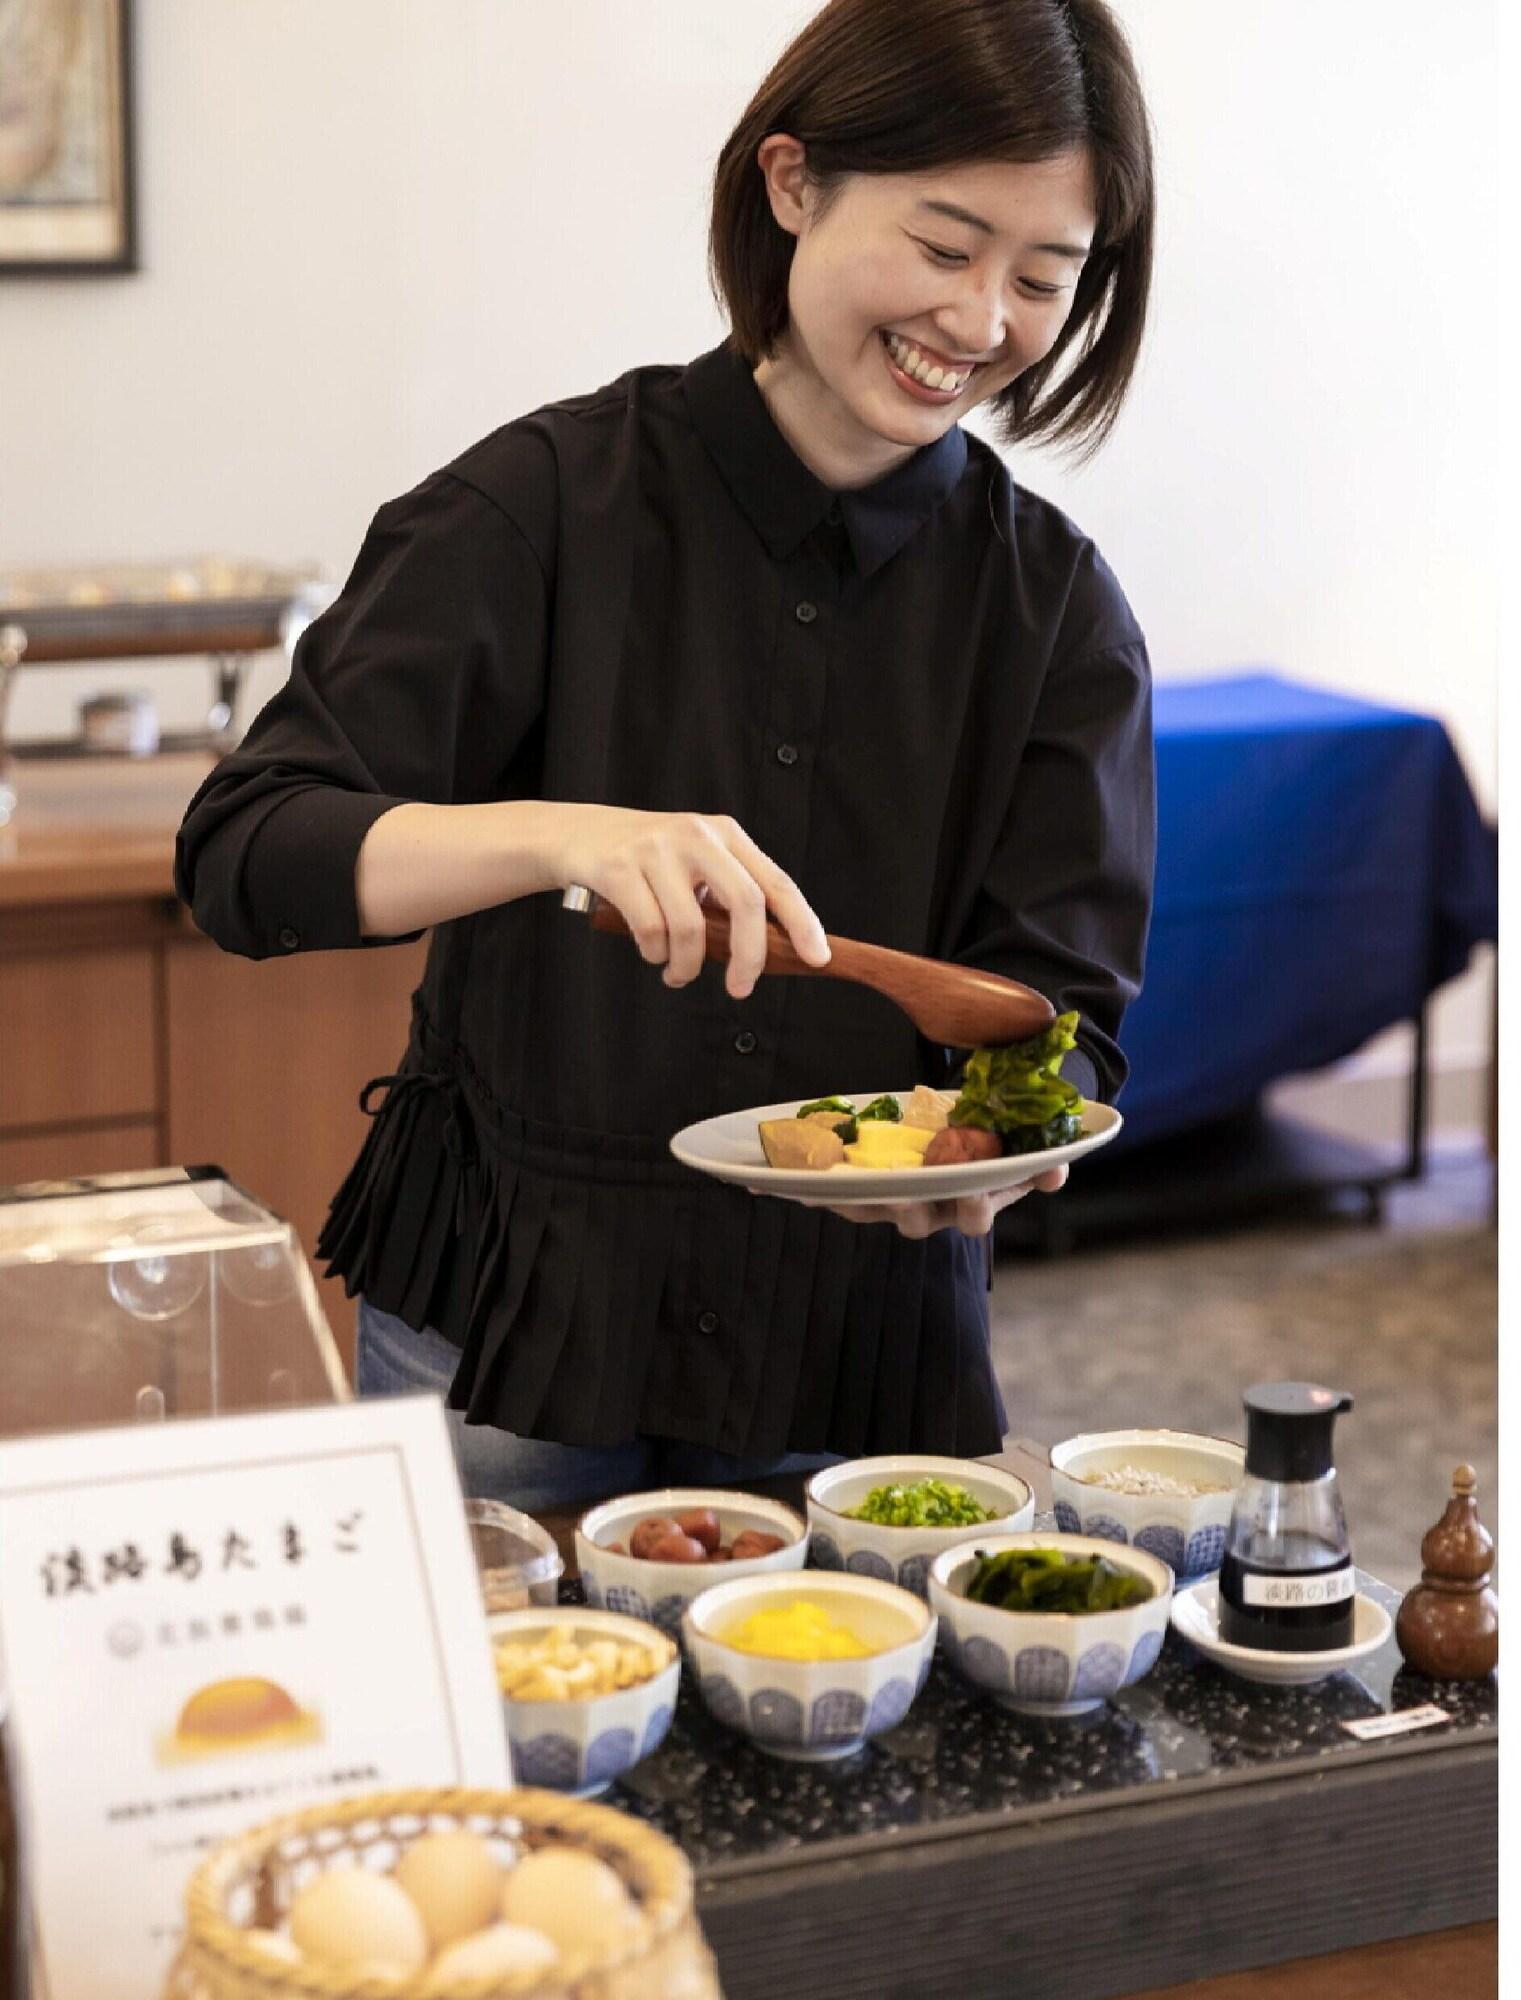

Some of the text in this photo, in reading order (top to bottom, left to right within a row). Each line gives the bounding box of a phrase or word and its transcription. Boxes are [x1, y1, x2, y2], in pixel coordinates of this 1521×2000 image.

[40, 1511, 364, 1598] 淡路島たまご
